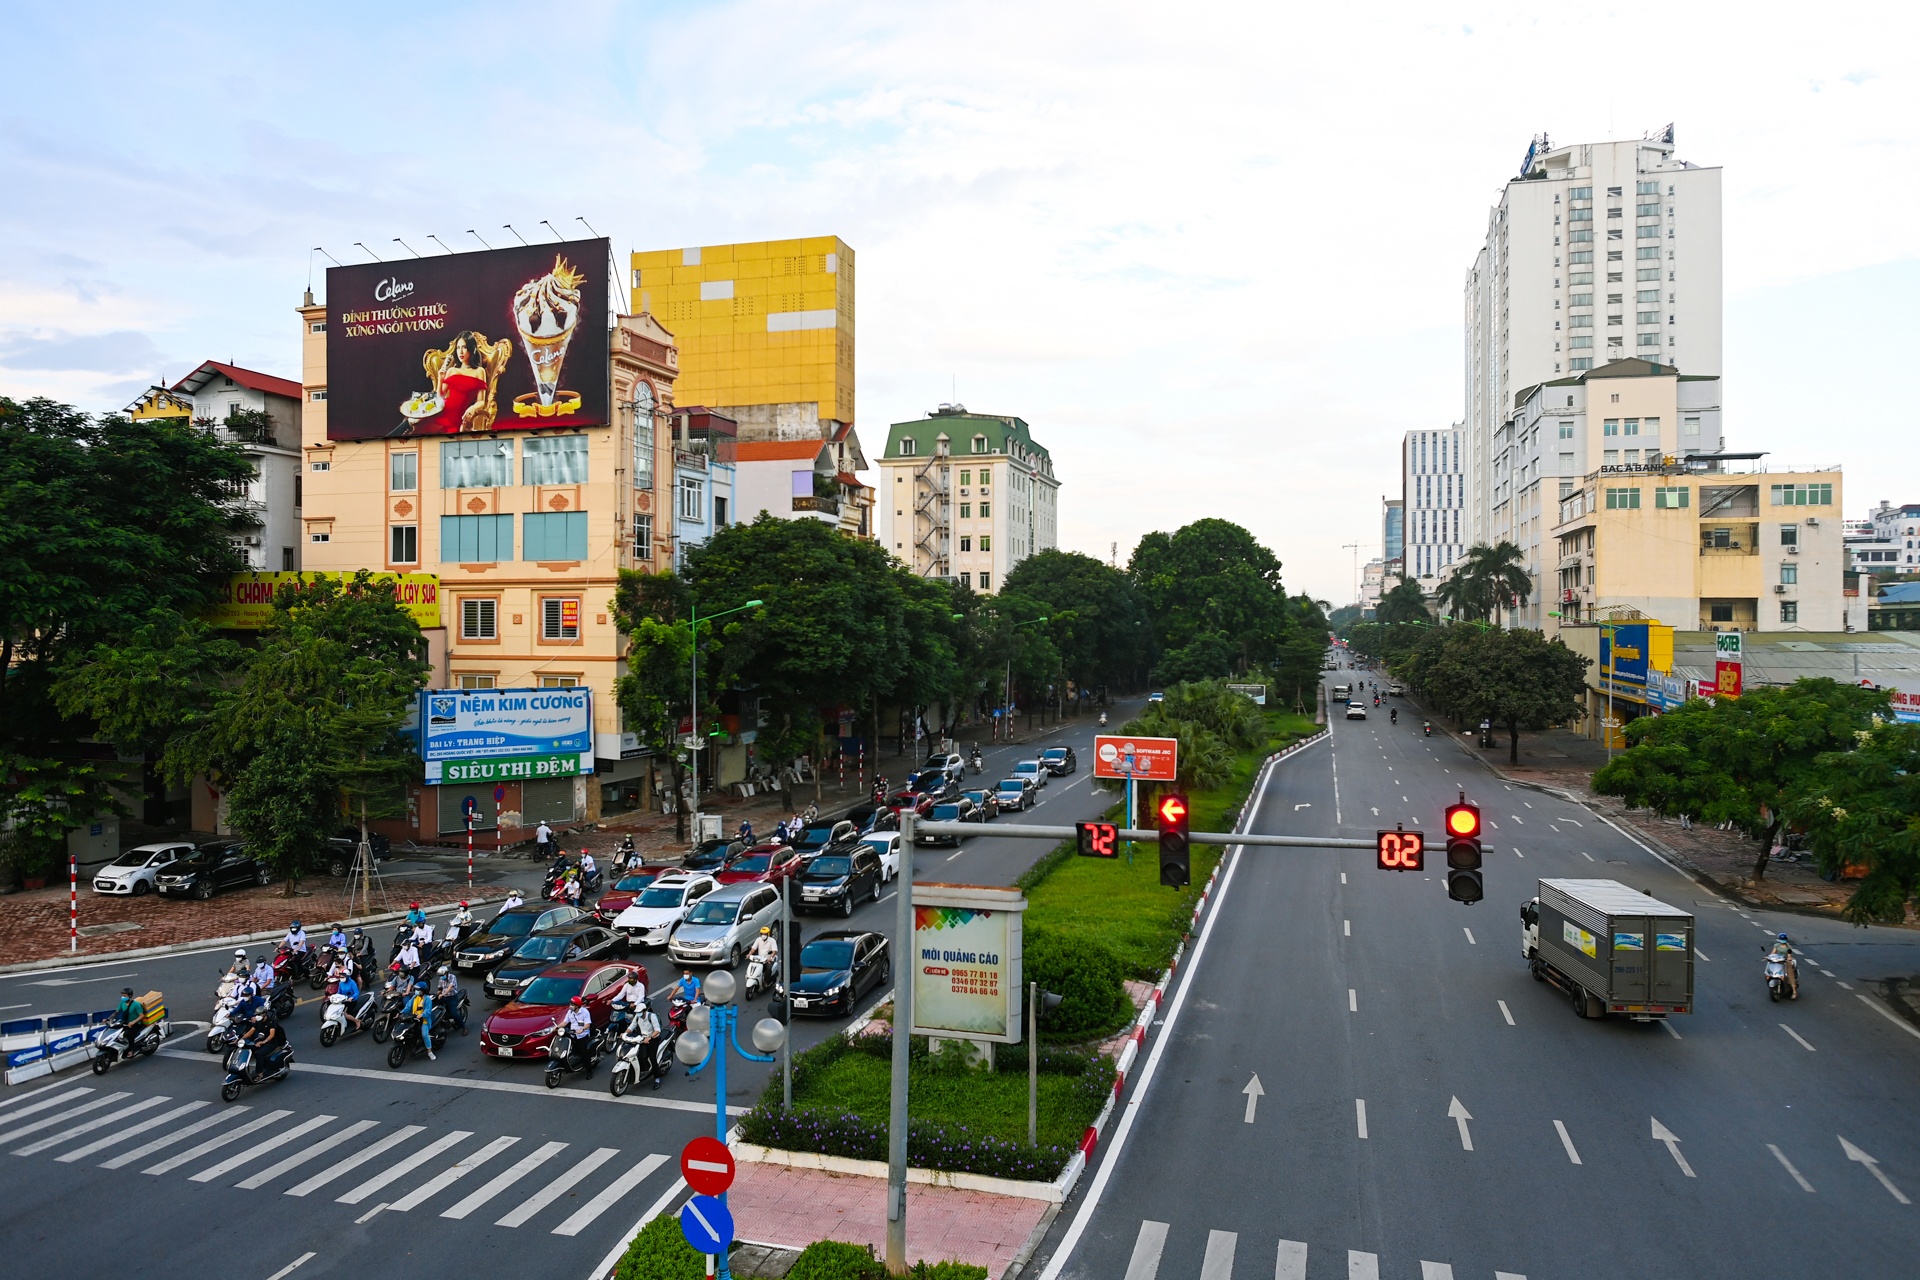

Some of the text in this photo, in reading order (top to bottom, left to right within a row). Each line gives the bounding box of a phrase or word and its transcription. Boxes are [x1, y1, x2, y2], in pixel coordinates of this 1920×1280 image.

[374, 276, 414, 301] Celano
[342, 302, 448, 324] ĐỈNH THƯỞNG THỨC
[345, 317, 444, 337] XỨNG NGÔI VƯƠNG
[530, 346, 565, 365] Celano
[1635, 463, 1666, 472] BANK
[237, 575, 273, 604] CHẤM
[1717, 634, 1740, 652] FASTER
[461, 695, 583, 716] NỆM KIM CƯƠNG
[457, 738, 484, 746] TRANG
[486, 736, 505, 746] HIỆP
[448, 757, 575, 779] SIÊU THỊ ĐỆM
[1084, 823, 1115, 855] 72
[1381, 833, 1420, 867] 02
[922, 947, 999, 965] MỜI QUẢNG CÁO
[951, 968, 968, 977] 0965
[969, 970, 978, 978] 77
[979, 971, 987, 979] 81
[951, 976, 968, 985] 0346
[969, 978, 978, 986] 07
[979, 979, 988, 987] 32
[951, 985, 968, 994] 0378
[969, 987, 978, 995] 64
[989, 988, 998, 996] 49
